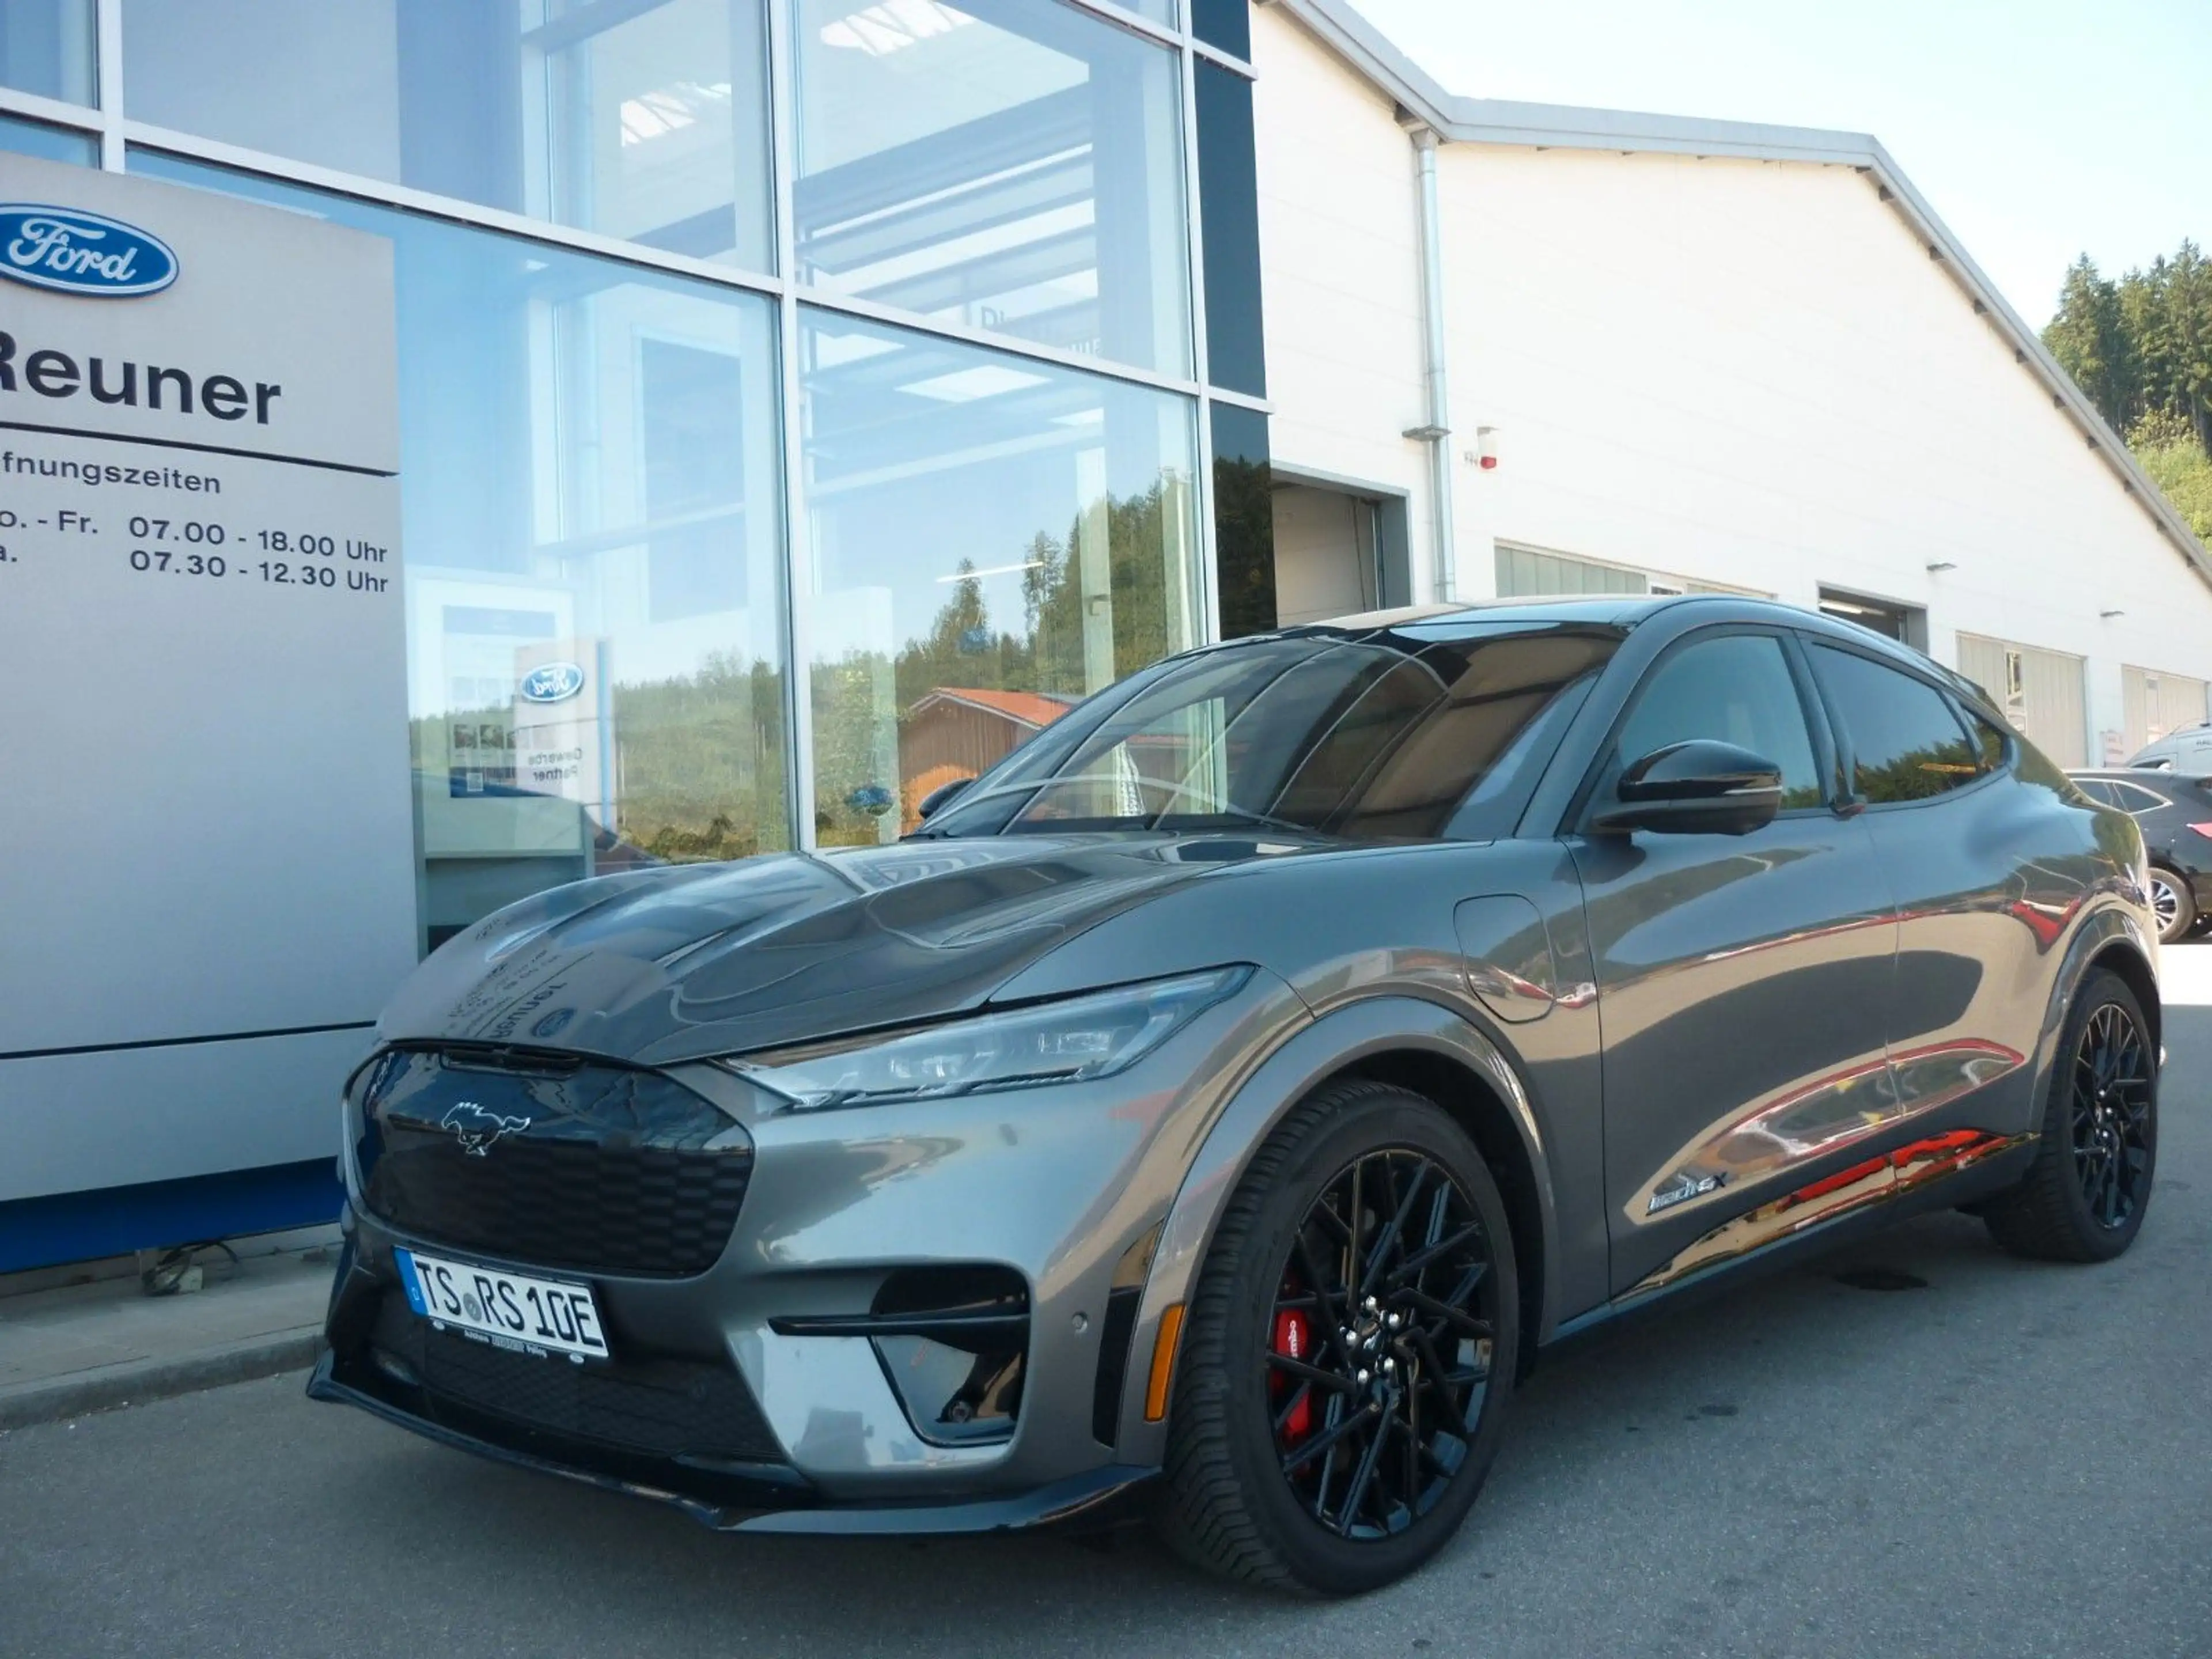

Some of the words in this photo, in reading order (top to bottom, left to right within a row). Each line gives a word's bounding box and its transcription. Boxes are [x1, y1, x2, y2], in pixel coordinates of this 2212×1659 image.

[9, 218, 138, 281] Ford
[59, 510, 99, 533] Fr.
[129, 516, 225, 545] 07.00
[257, 530, 335, 556] 18.00
[346, 540, 387, 562] Uhr
[130, 550, 226, 577] 07.30
[259, 562, 336, 587] 12.30
[347, 570, 388, 592] Uhr
[414, 1262, 461, 1316] TS
[472, 1274, 525, 1331] RS
